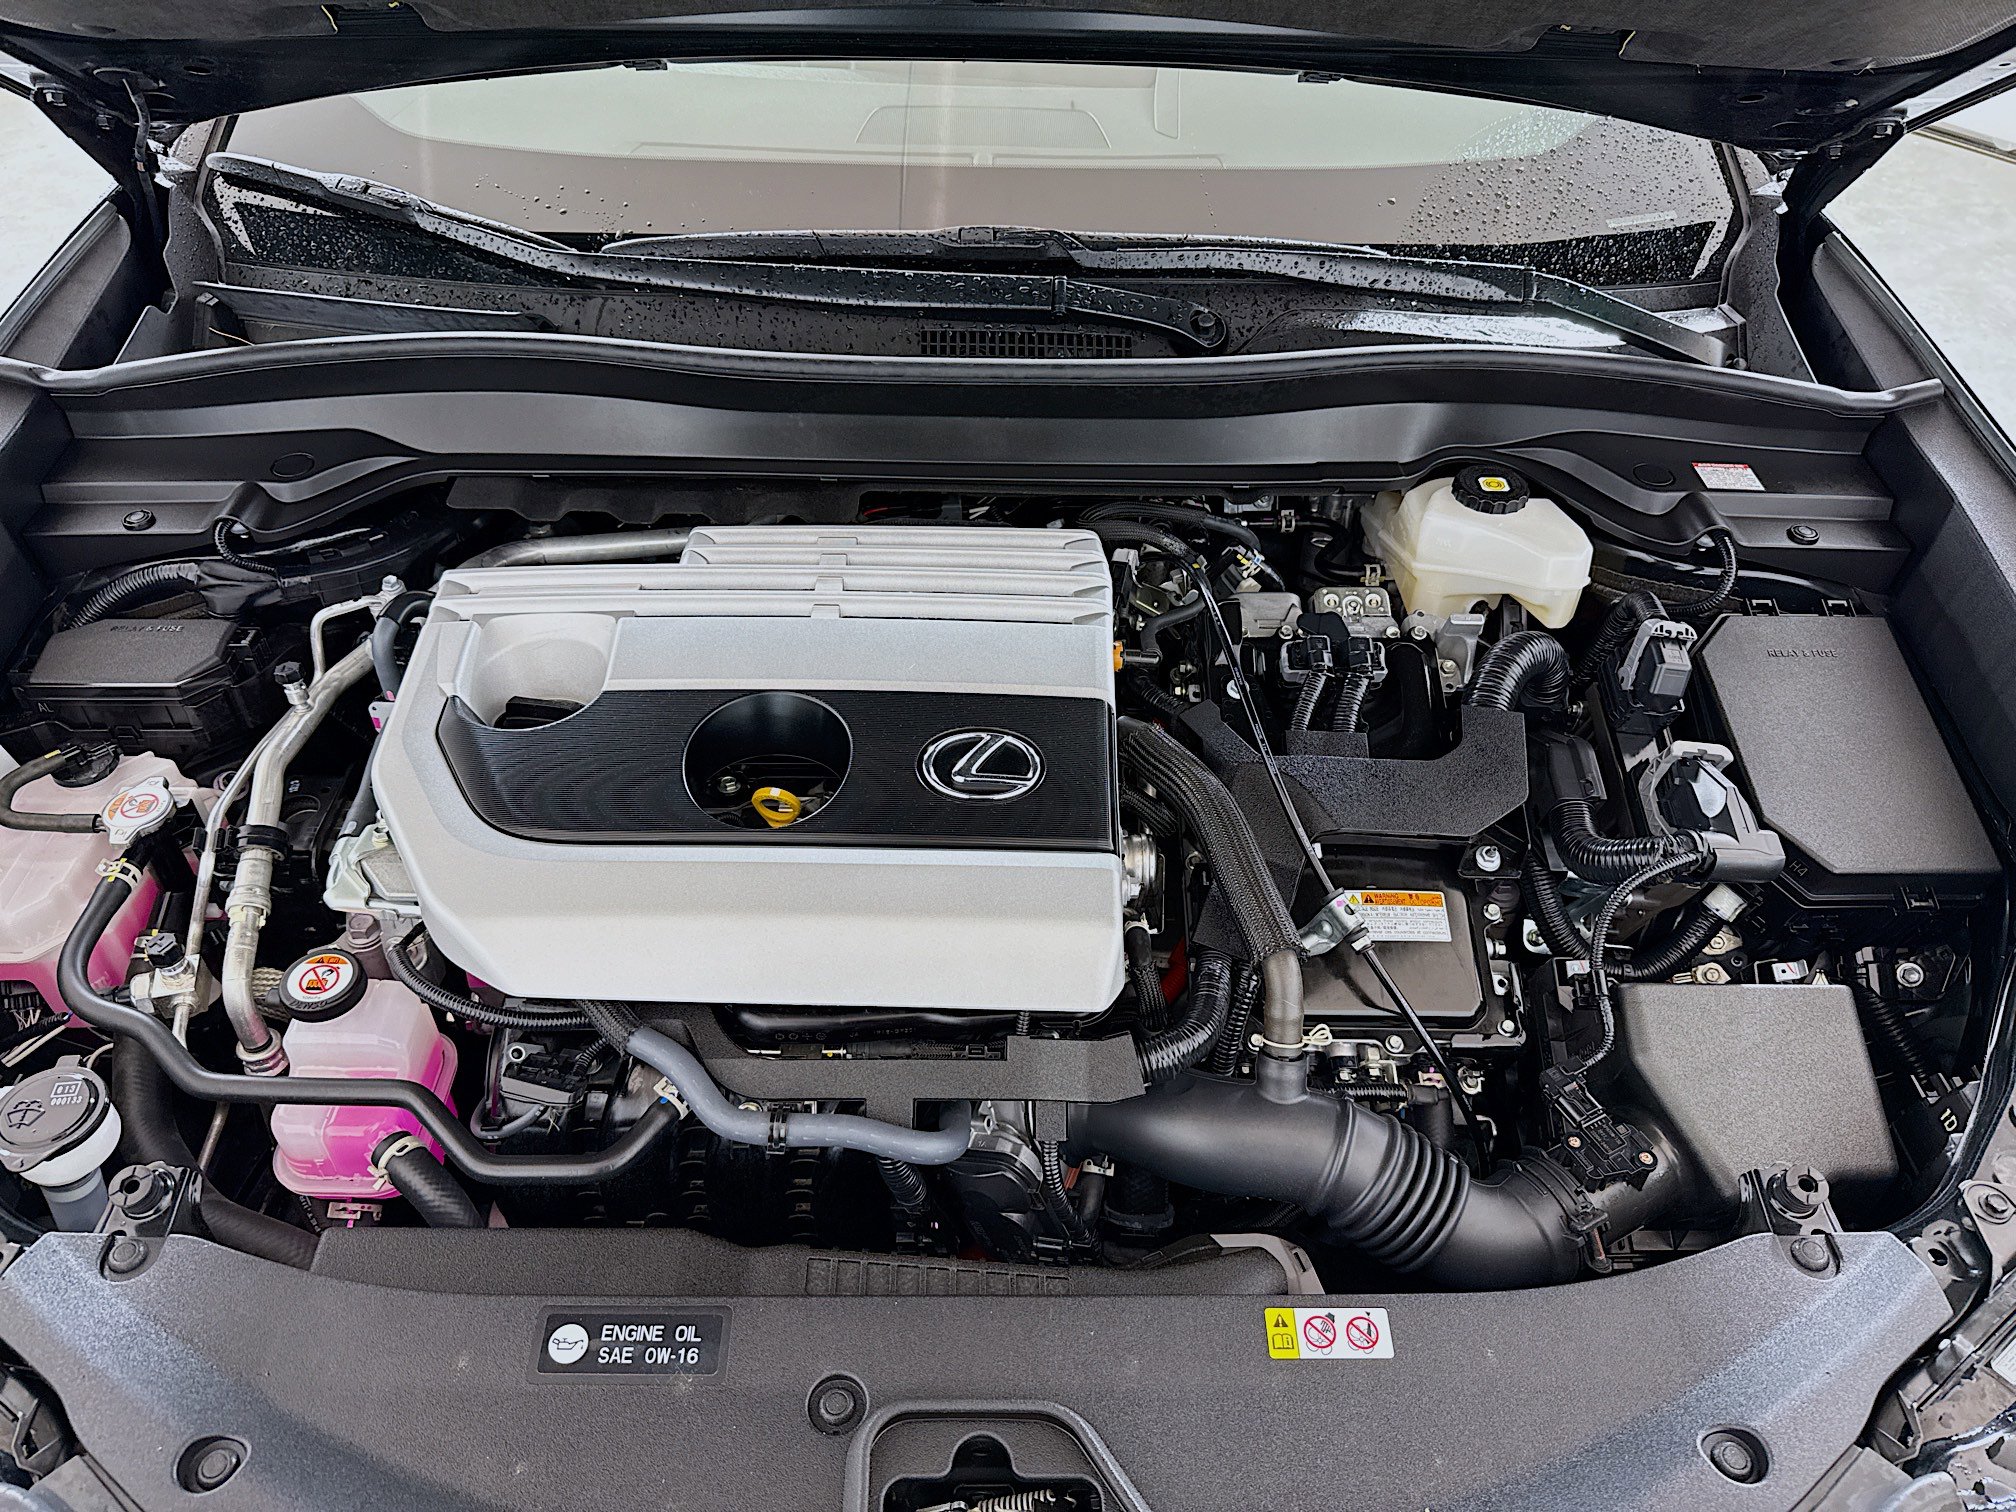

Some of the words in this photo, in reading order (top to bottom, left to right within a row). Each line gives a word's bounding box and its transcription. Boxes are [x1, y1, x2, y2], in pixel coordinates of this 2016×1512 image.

[1766, 648, 1799, 658] RELAY
[1801, 649, 1810, 658] &
[1811, 649, 1838, 658] FUSE
[288, 1000, 327, 1010] DENSO
[50, 1095, 83, 1106] 000133
[601, 1325, 665, 1342] ENGINE
[675, 1325, 702, 1342] OIL
[597, 1347, 635, 1364] SAE
[644, 1347, 699, 1364] 0W-16
